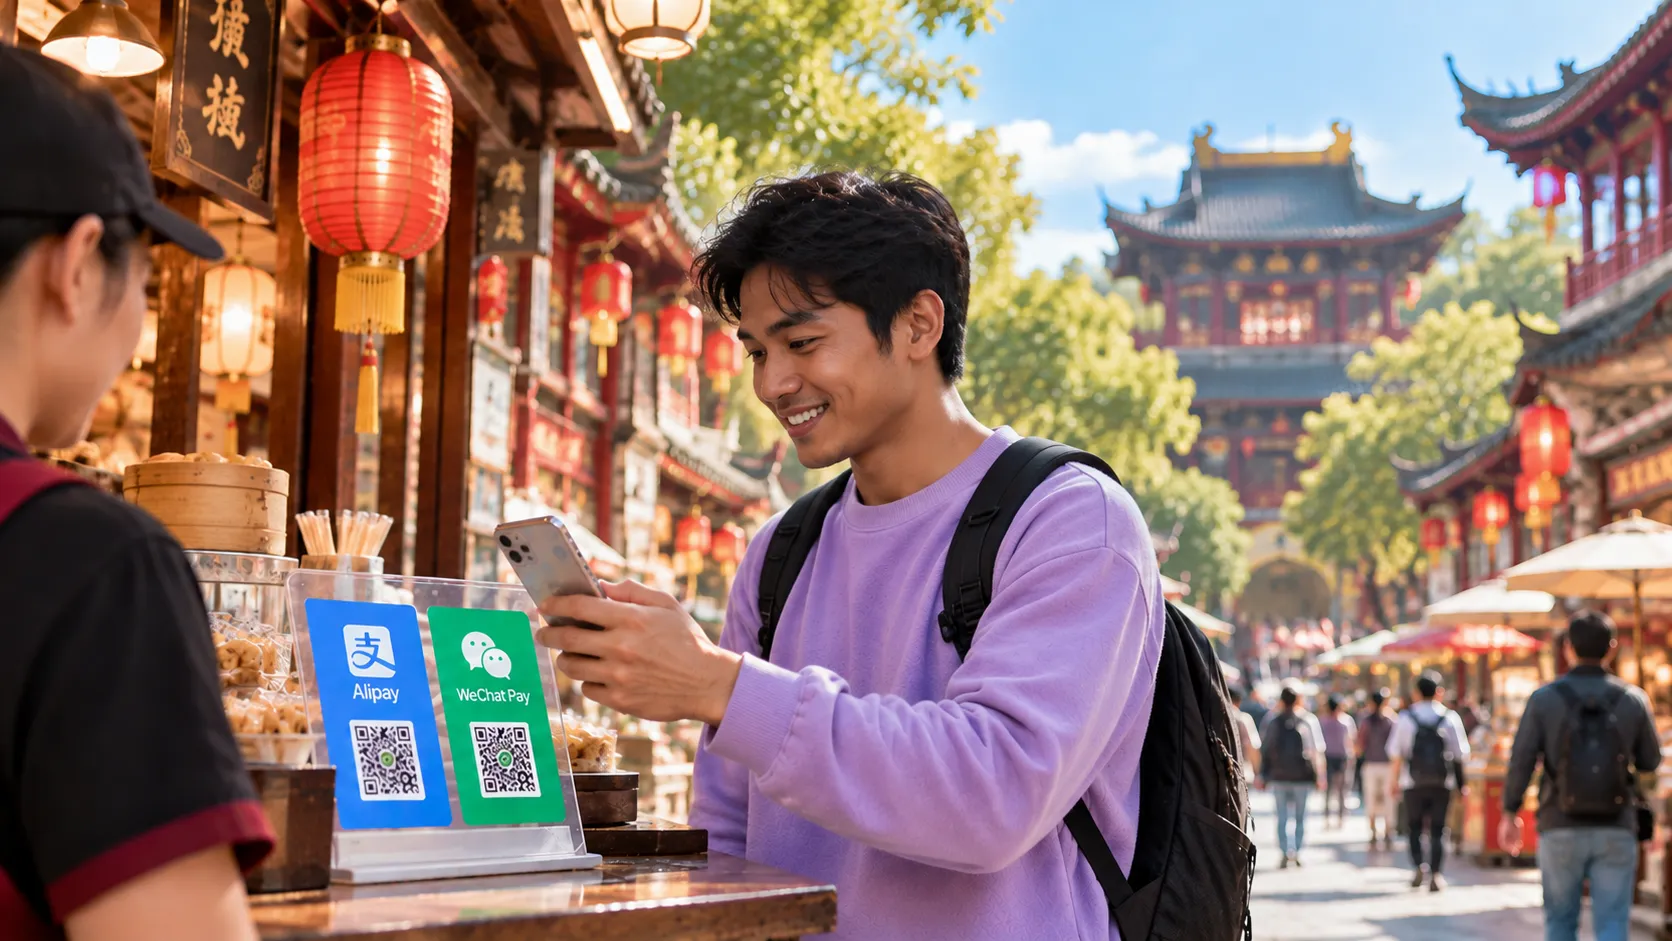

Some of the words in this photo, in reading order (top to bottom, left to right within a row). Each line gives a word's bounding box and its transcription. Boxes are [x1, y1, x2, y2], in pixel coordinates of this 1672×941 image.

[351, 632, 396, 669] 支
[353, 683, 399, 704] Alipay
[456, 688, 506, 702] WeChat
[507, 689, 530, 706] Pay
